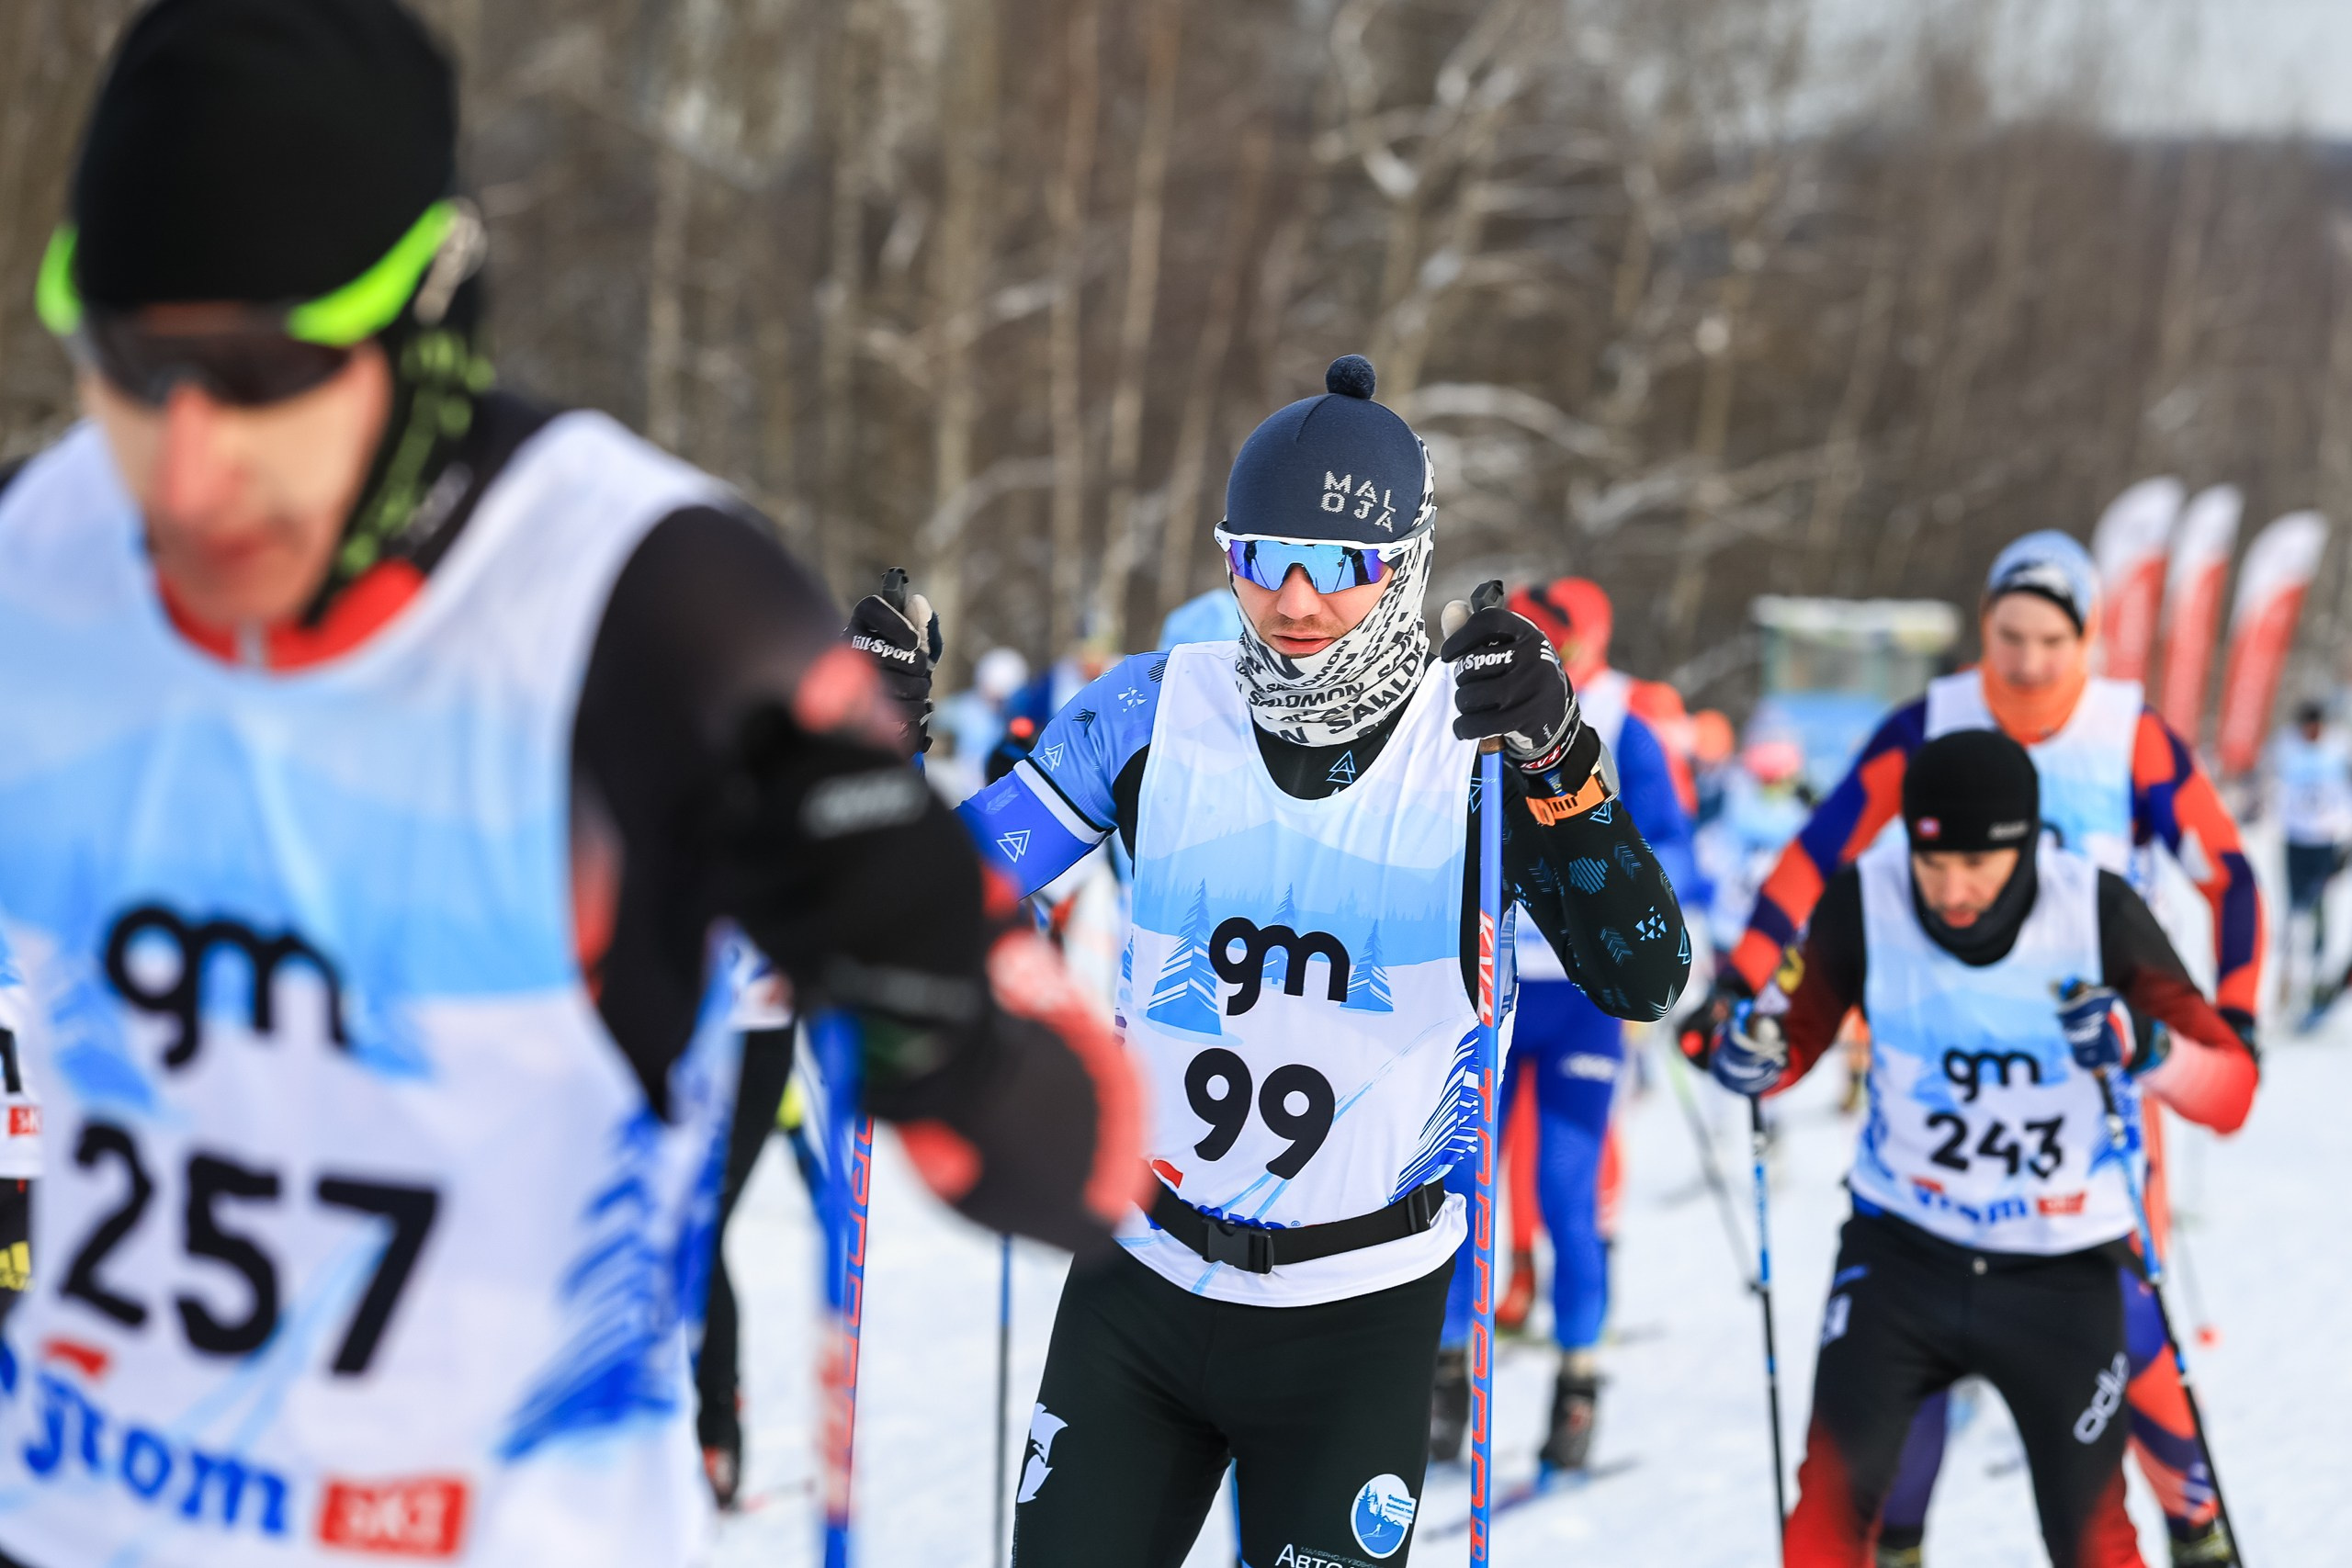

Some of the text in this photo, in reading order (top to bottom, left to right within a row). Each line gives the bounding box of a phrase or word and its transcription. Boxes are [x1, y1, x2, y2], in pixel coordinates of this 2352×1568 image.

[1320, 491, 1394, 534] OJA
[1323, 470, 1397, 513] MAL
[103, 906, 354, 1073] gm
[1208, 916, 1351, 1017] gm
[1184, 1047, 1336, 1180] 99
[1943, 1045, 2041, 1102] gm
[1925, 1111, 2066, 1179] 243
[60, 1115, 443, 1378] 257
